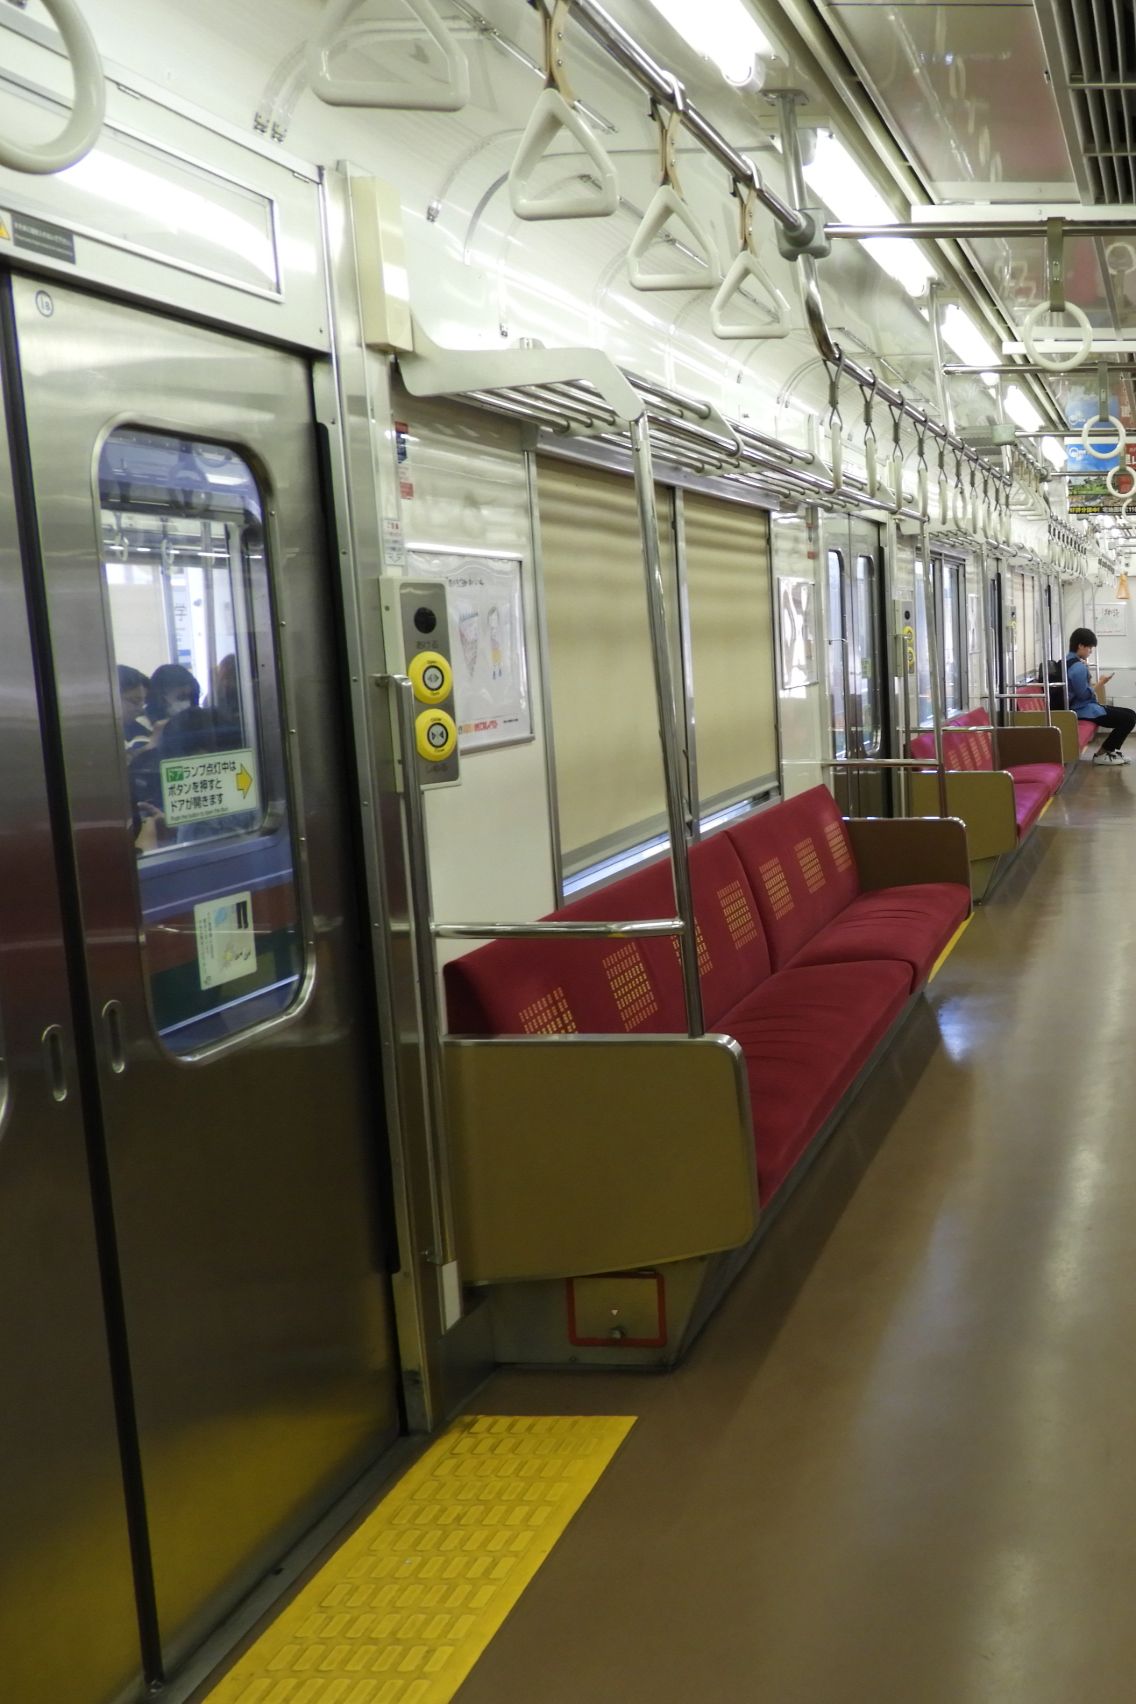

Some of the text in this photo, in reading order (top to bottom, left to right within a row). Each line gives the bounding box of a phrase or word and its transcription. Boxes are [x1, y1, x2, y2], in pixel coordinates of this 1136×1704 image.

[171, 793, 224, 813] ドアが開きます
